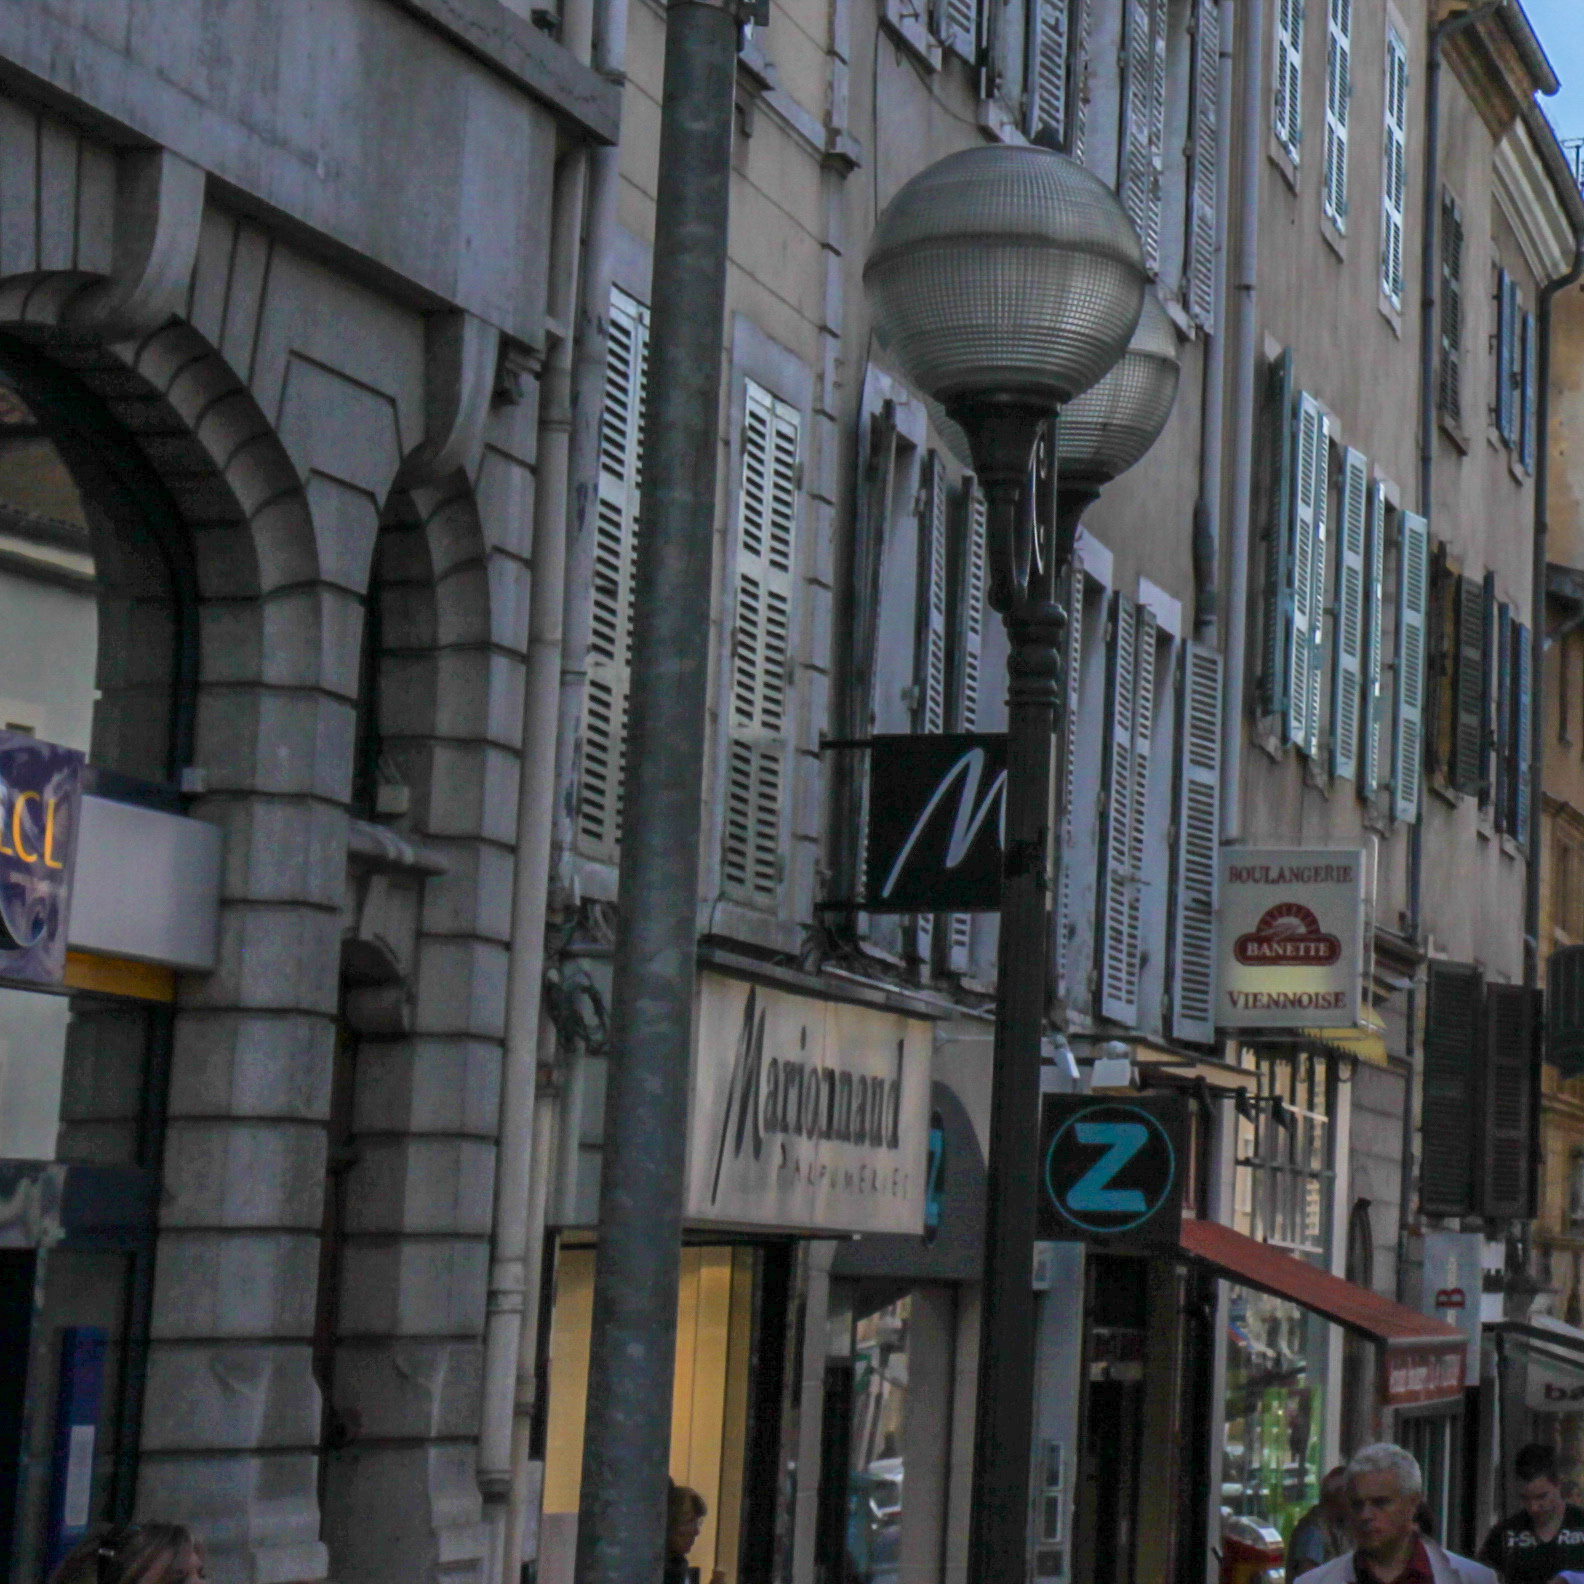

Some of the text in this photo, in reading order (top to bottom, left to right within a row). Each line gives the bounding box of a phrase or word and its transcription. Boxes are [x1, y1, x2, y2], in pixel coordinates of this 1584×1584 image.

[1228, 865, 1353, 884] BOULANGERIE
[1246, 941, 1330, 956] BANETTE
[1227, 990, 1347, 1010] VIENNOISE
[711, 984, 904, 1207] Marionnaud
[1066, 1122, 1149, 1212] Z
